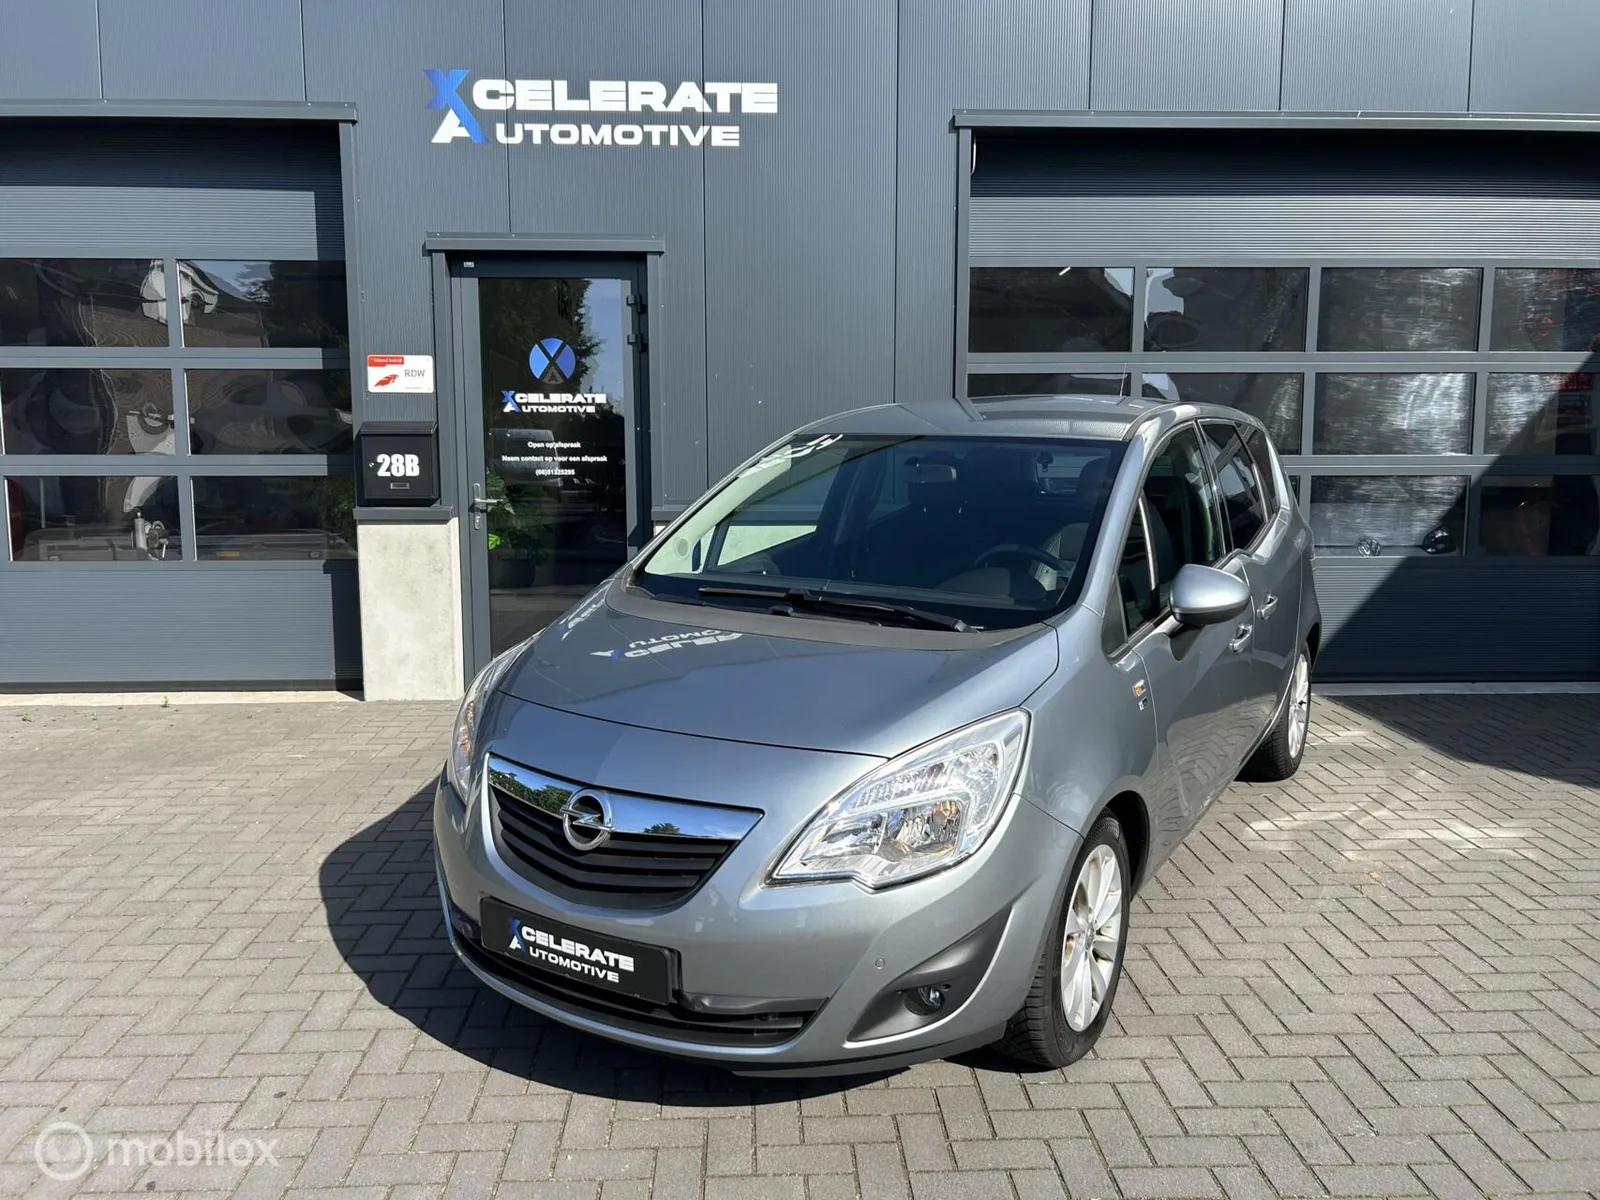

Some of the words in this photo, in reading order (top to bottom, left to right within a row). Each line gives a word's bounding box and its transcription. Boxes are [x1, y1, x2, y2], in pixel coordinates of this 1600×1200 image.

[423, 68, 778, 114] XCELERATE
[431, 108, 740, 147] AUTOMOTIVE
[404, 369, 426, 378] RDW
[527, 441, 545, 449] Open
[554, 441, 581, 449] afspraak
[377, 453, 420, 477] 28B
[581, 455, 608, 463] afspraak
[509, 917, 635, 972] XCELERATE
